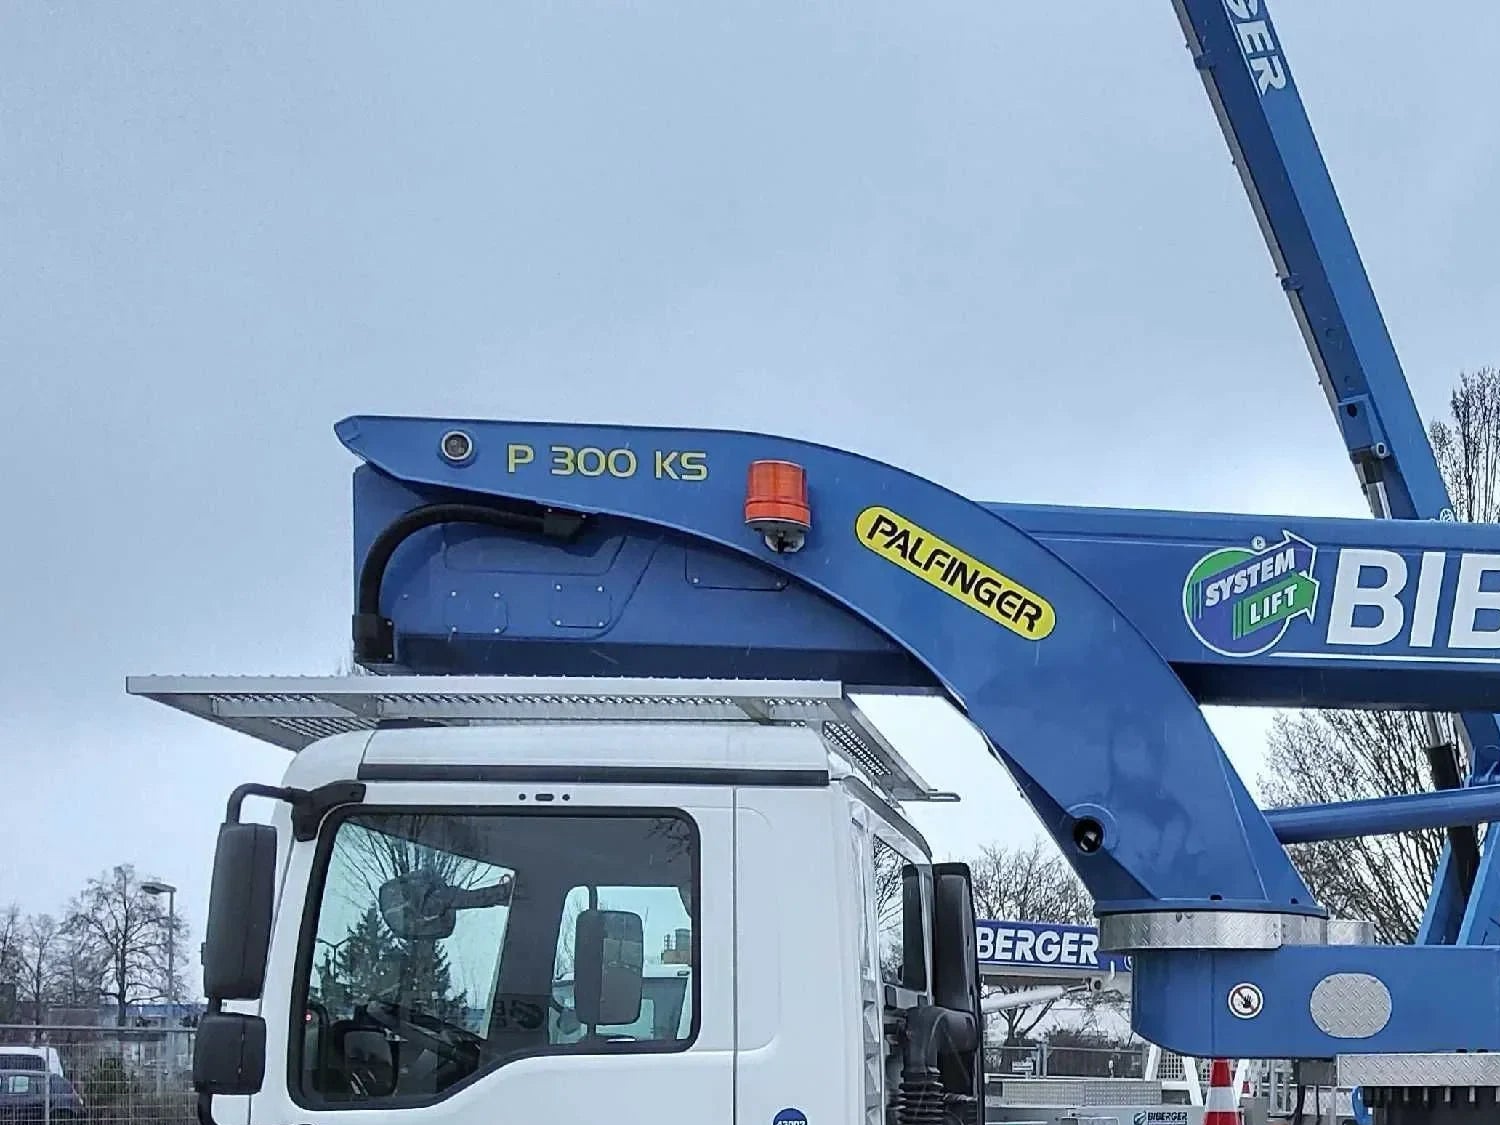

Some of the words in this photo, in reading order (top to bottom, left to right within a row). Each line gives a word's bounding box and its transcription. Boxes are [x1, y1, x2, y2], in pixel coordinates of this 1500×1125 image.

[506, 444, 534, 473] P
[550, 447, 637, 478] 300
[654, 450, 709, 481] KS
[866, 514, 1042, 632] PALFINGER
[1205, 547, 1296, 607] SYSTEM
[1249, 583, 1298, 625] LIFT
[1147, 1111, 1188, 1122] BIBERGER
